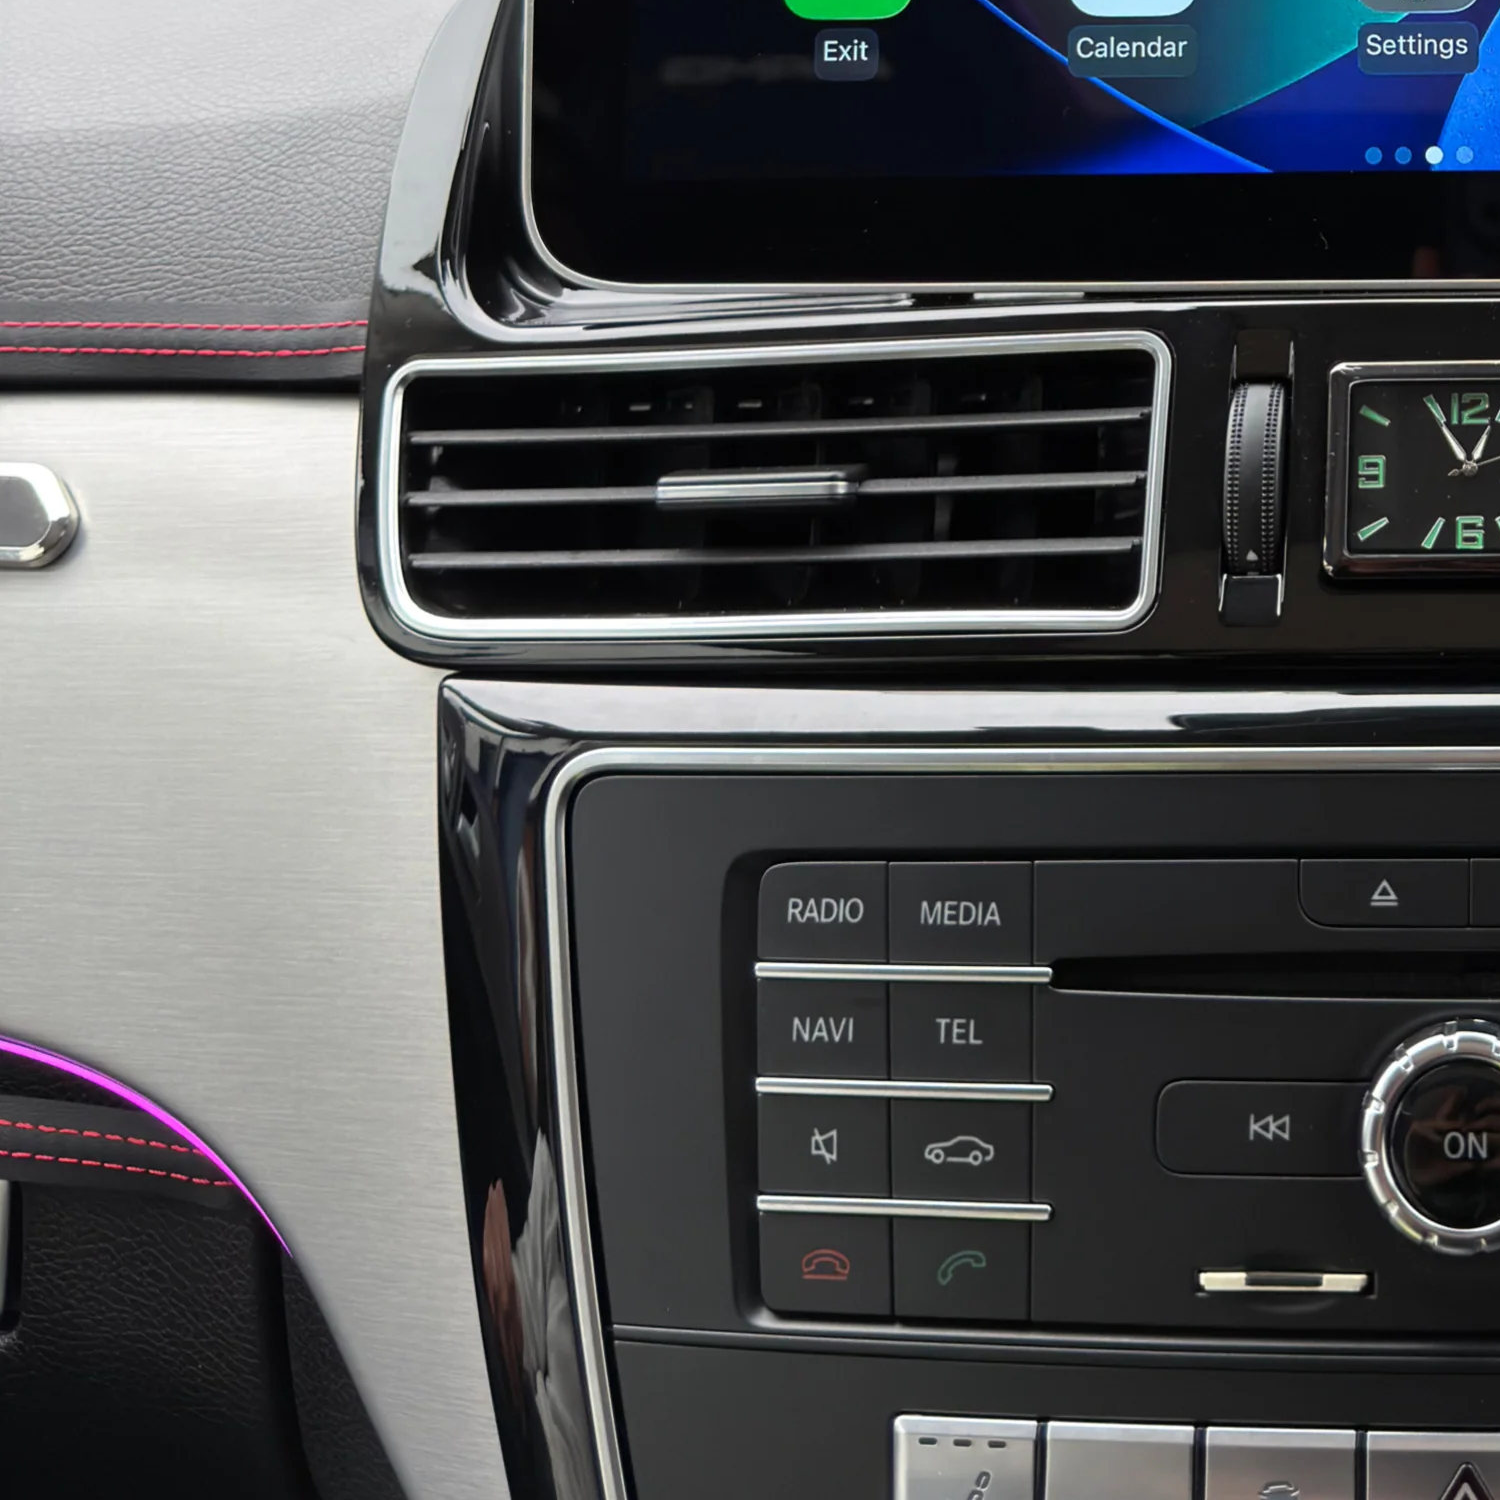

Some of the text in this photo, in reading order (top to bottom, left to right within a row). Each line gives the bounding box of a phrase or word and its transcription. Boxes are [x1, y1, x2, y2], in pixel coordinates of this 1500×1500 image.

[823, 38, 869, 62] Exit
[1076, 35, 1188, 59] Calendar
[1366, 32, 1468, 60] Settings
[1448, 391, 1491, 426] 12
[1357, 454, 1387, 489] 9
[1454, 514, 1485, 550] 6
[787, 897, 864, 923] RADIO
[920, 900, 1001, 926] MEDIA
[792, 1016, 854, 1043] NAVI
[935, 1018, 983, 1045] TEL
[1443, 1131, 1488, 1159] ON
